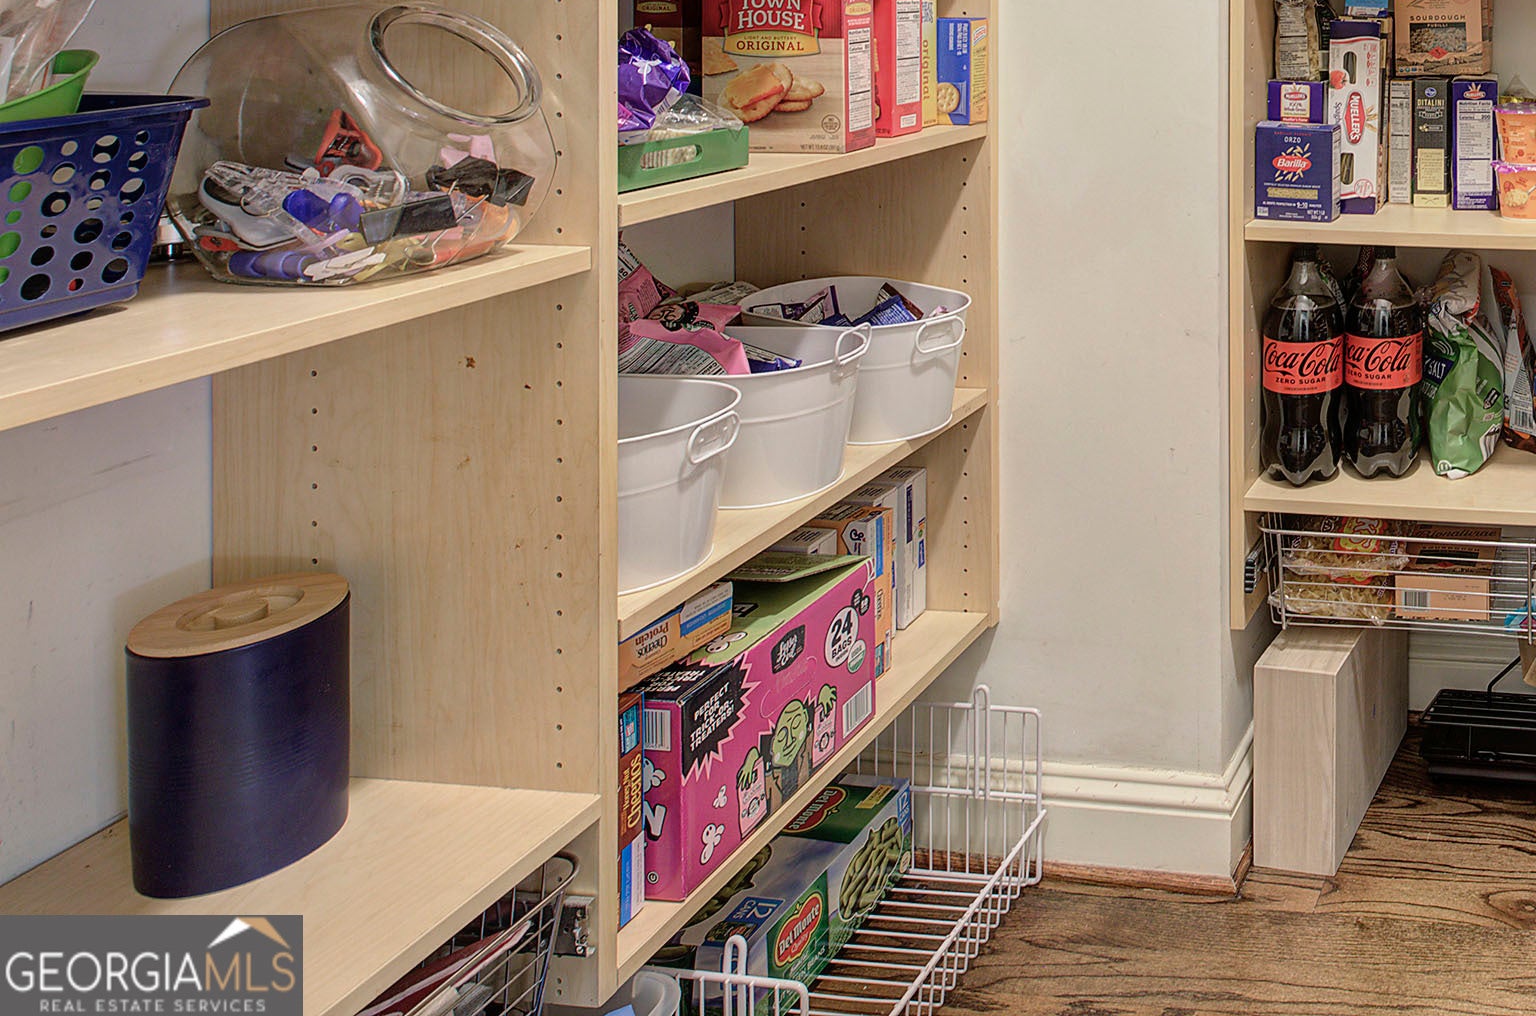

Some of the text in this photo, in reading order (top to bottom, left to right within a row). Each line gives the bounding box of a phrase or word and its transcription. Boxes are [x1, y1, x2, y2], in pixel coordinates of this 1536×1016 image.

[737, 10, 806, 31] HOUSE
[736, 40, 805, 52] ORIGINAL
[921, 39, 930, 101] original
[1417, 98, 1445, 107] DITALINI
[1284, 135, 1302, 144] ORZO
[1276, 157, 1308, 169] Barilla
[1264, 339, 1341, 377] Coca-Cola
[1428, 356, 1447, 380] SALT
[1275, 376, 1327, 385] ZERO SUGAR
[1364, 371, 1393, 380] SUGAR
[634, 621, 669, 645] Protein
[830, 608, 853, 649] 24
[636, 633, 668, 659] Cheerios
[831, 638, 853, 660] BAGS
[693, 681, 730, 721] PERFECT
[703, 702, 721, 723] FOR
[689, 704, 735, 752] TREATERS!
[627, 752, 643, 829] Cheerios
[778, 903, 820, 953] Del Monte
